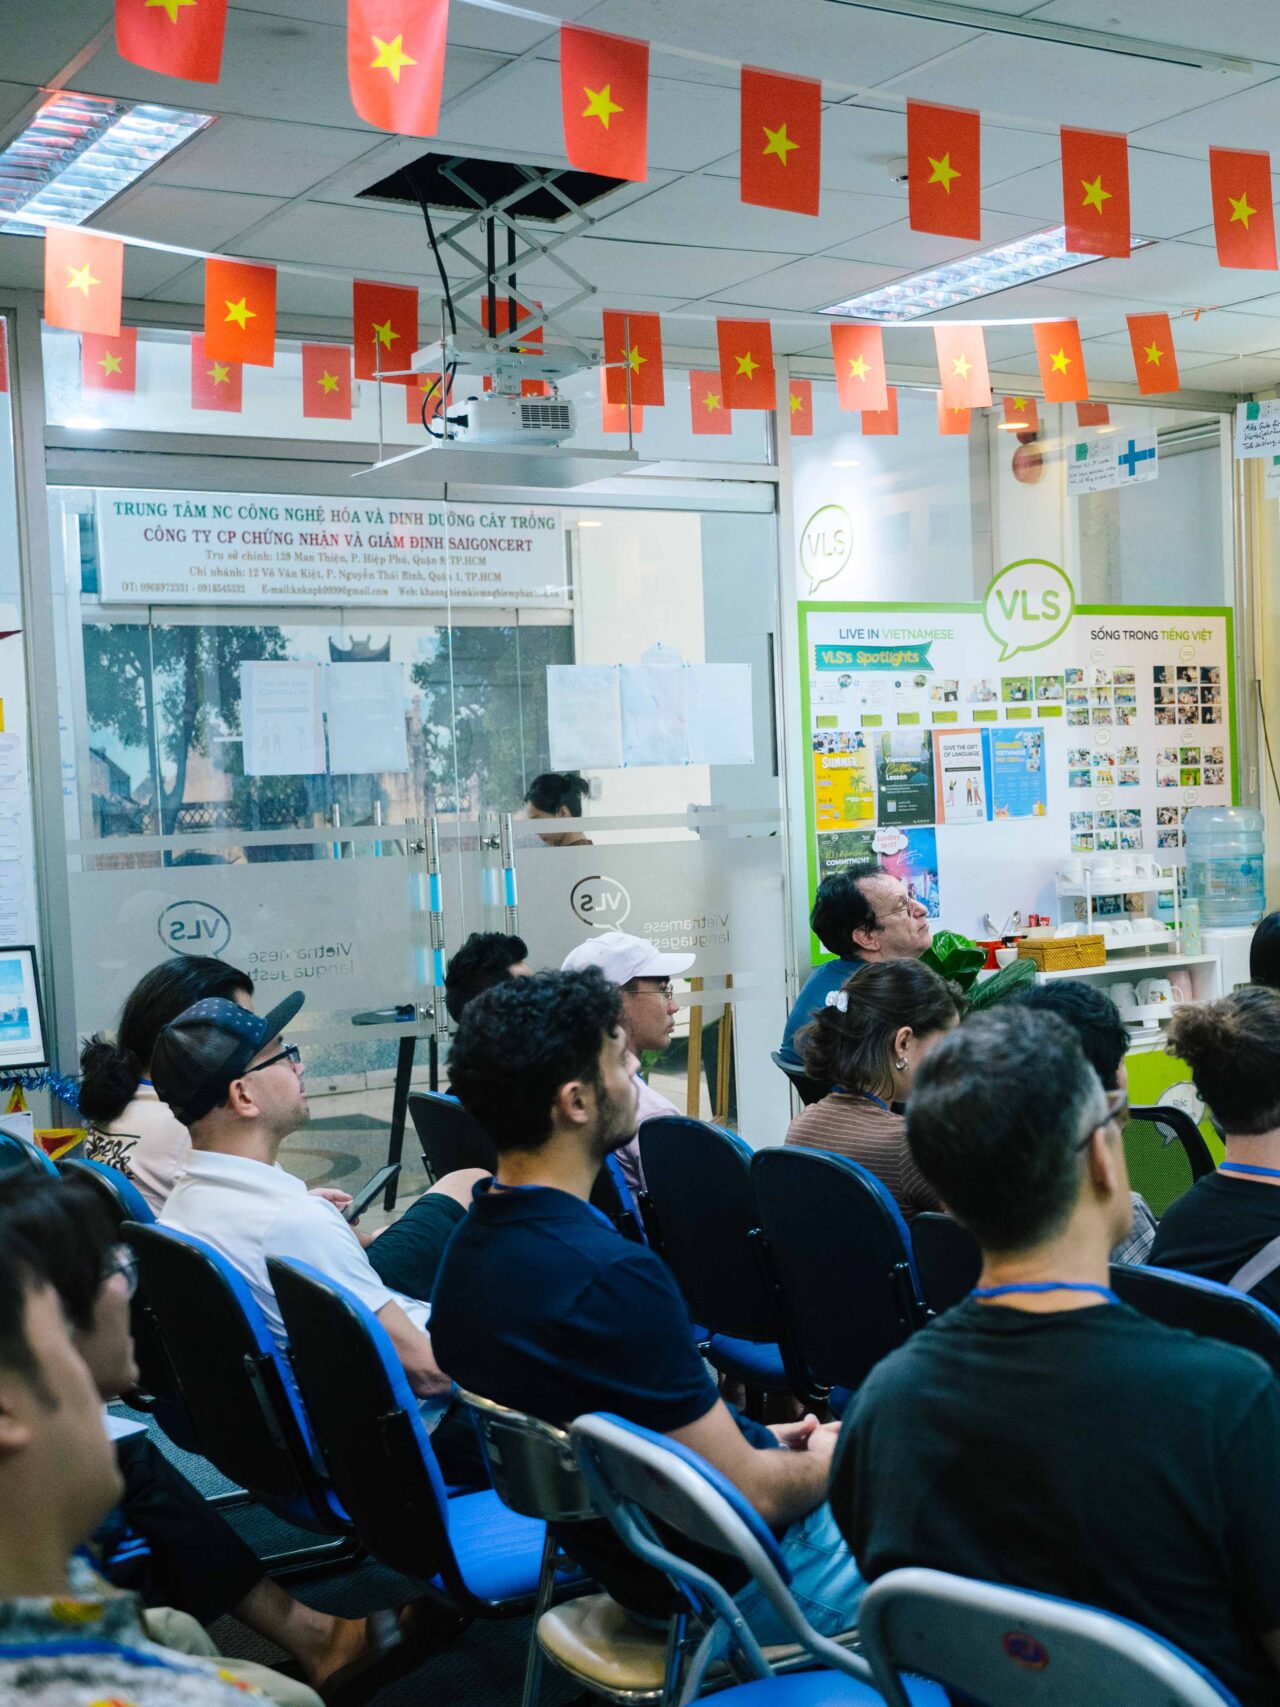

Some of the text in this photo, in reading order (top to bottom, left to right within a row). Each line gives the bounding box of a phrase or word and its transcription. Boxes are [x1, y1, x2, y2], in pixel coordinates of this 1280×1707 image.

[113, 501, 168, 517] TRUNG
[173, 501, 206, 518] TÂM
[212, 505, 233, 519] NC
[238, 503, 280, 520] CÔNG
[284, 506, 325, 525] NGHỆ
[331, 506, 360, 523] HÓA
[365, 508, 384, 524] VÀ
[480, 512, 505, 529] CÂY
[512, 510, 556, 530] TRỒNG
[144, 525, 533, 552] CÔNG TY CP CHỨNG NHẬN VÀ GIÁM ĐỊNH SAIGONCERT
[807, 529, 845, 558] VLS
[450, 556, 487, 566] TP.HCM
[249, 568, 259, 577] 12
[326, 570, 336, 579] P.
[466, 573, 502, 582] TP.HCM
[996, 588, 1061, 622] VLS
[839, 628, 955, 640] LIVE IN VIETNAMESE
[1090, 626, 1213, 643] SỐNG TRONG TIẾNG VIỆT
[821, 651, 919, 667] VLS's Spotlights
